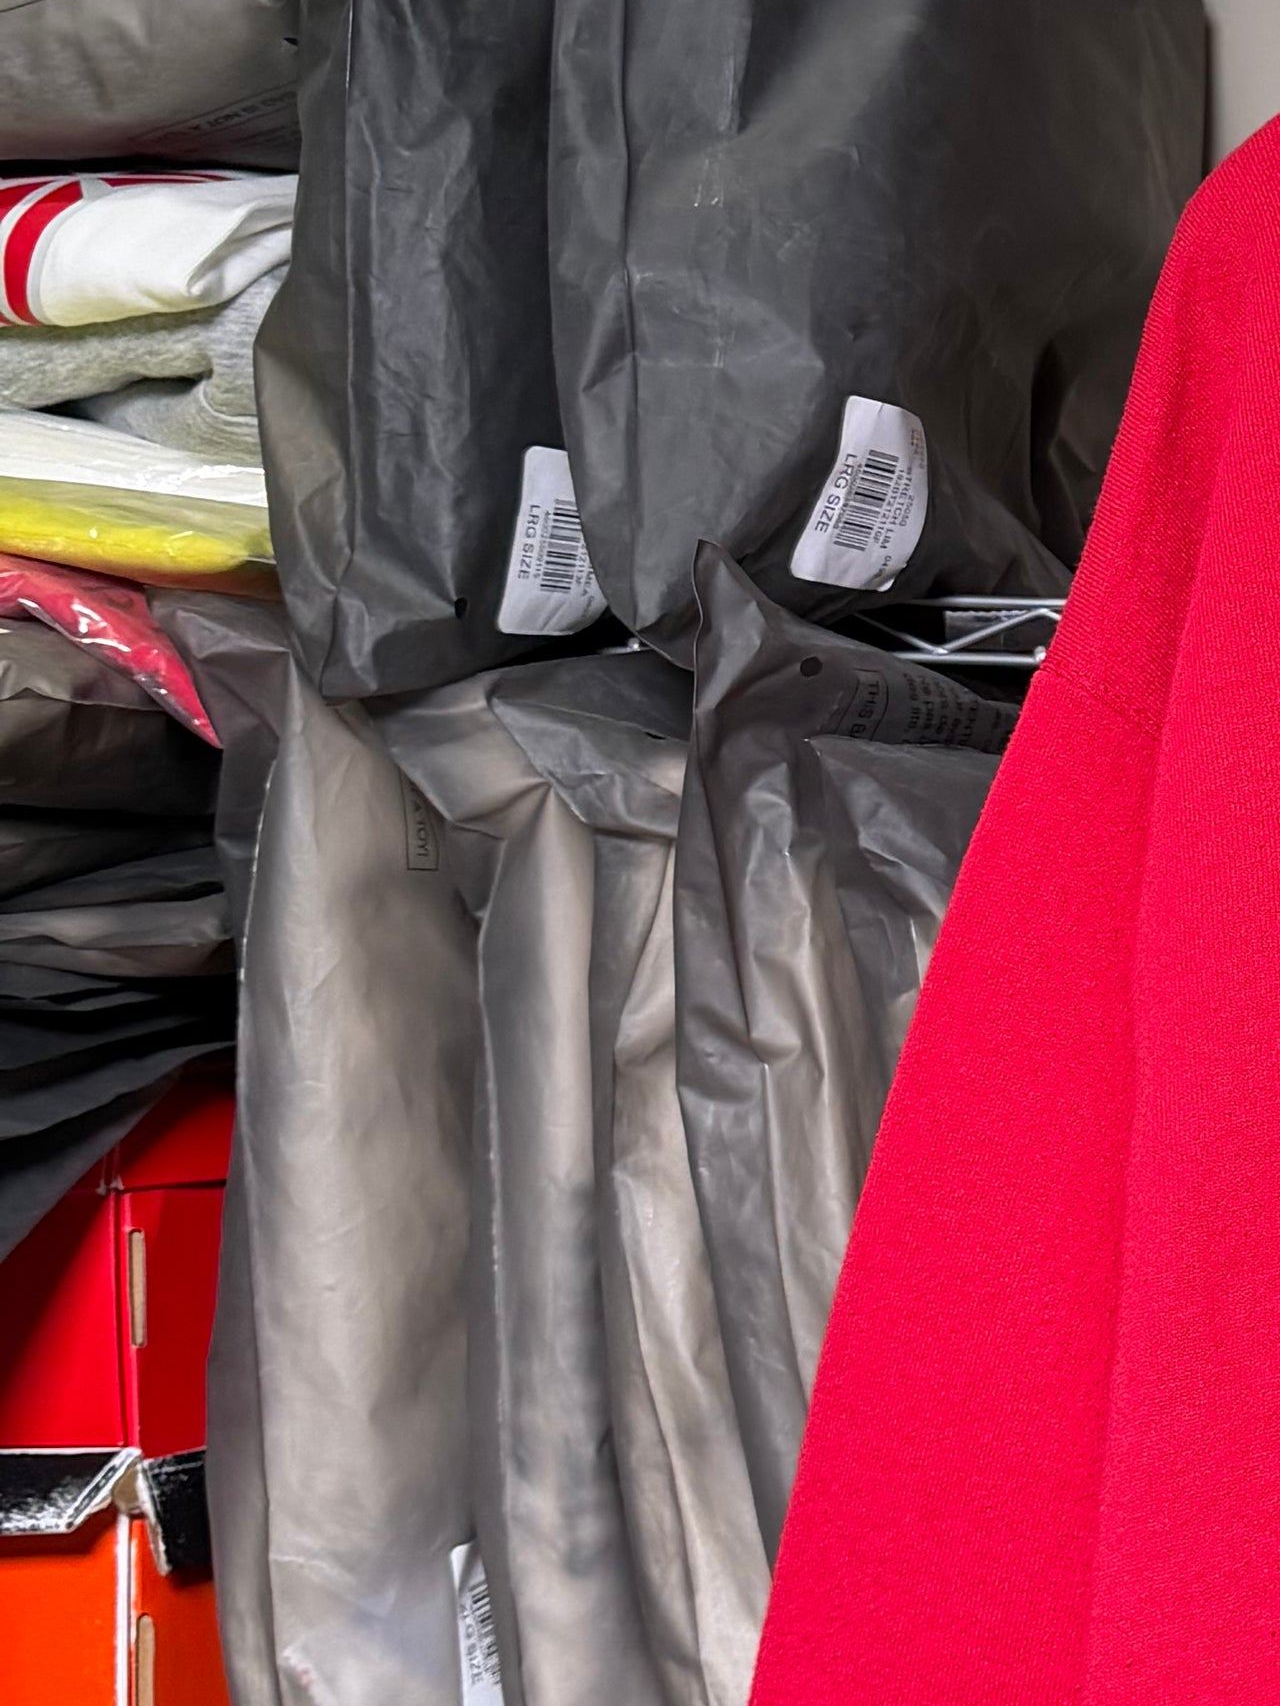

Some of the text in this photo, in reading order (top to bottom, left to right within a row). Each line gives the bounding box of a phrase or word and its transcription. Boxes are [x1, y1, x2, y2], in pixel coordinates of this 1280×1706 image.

[834, 453, 858, 490] LRG
[814, 493, 843, 534] SIZE
[517, 504, 541, 580] LRG SIZE
